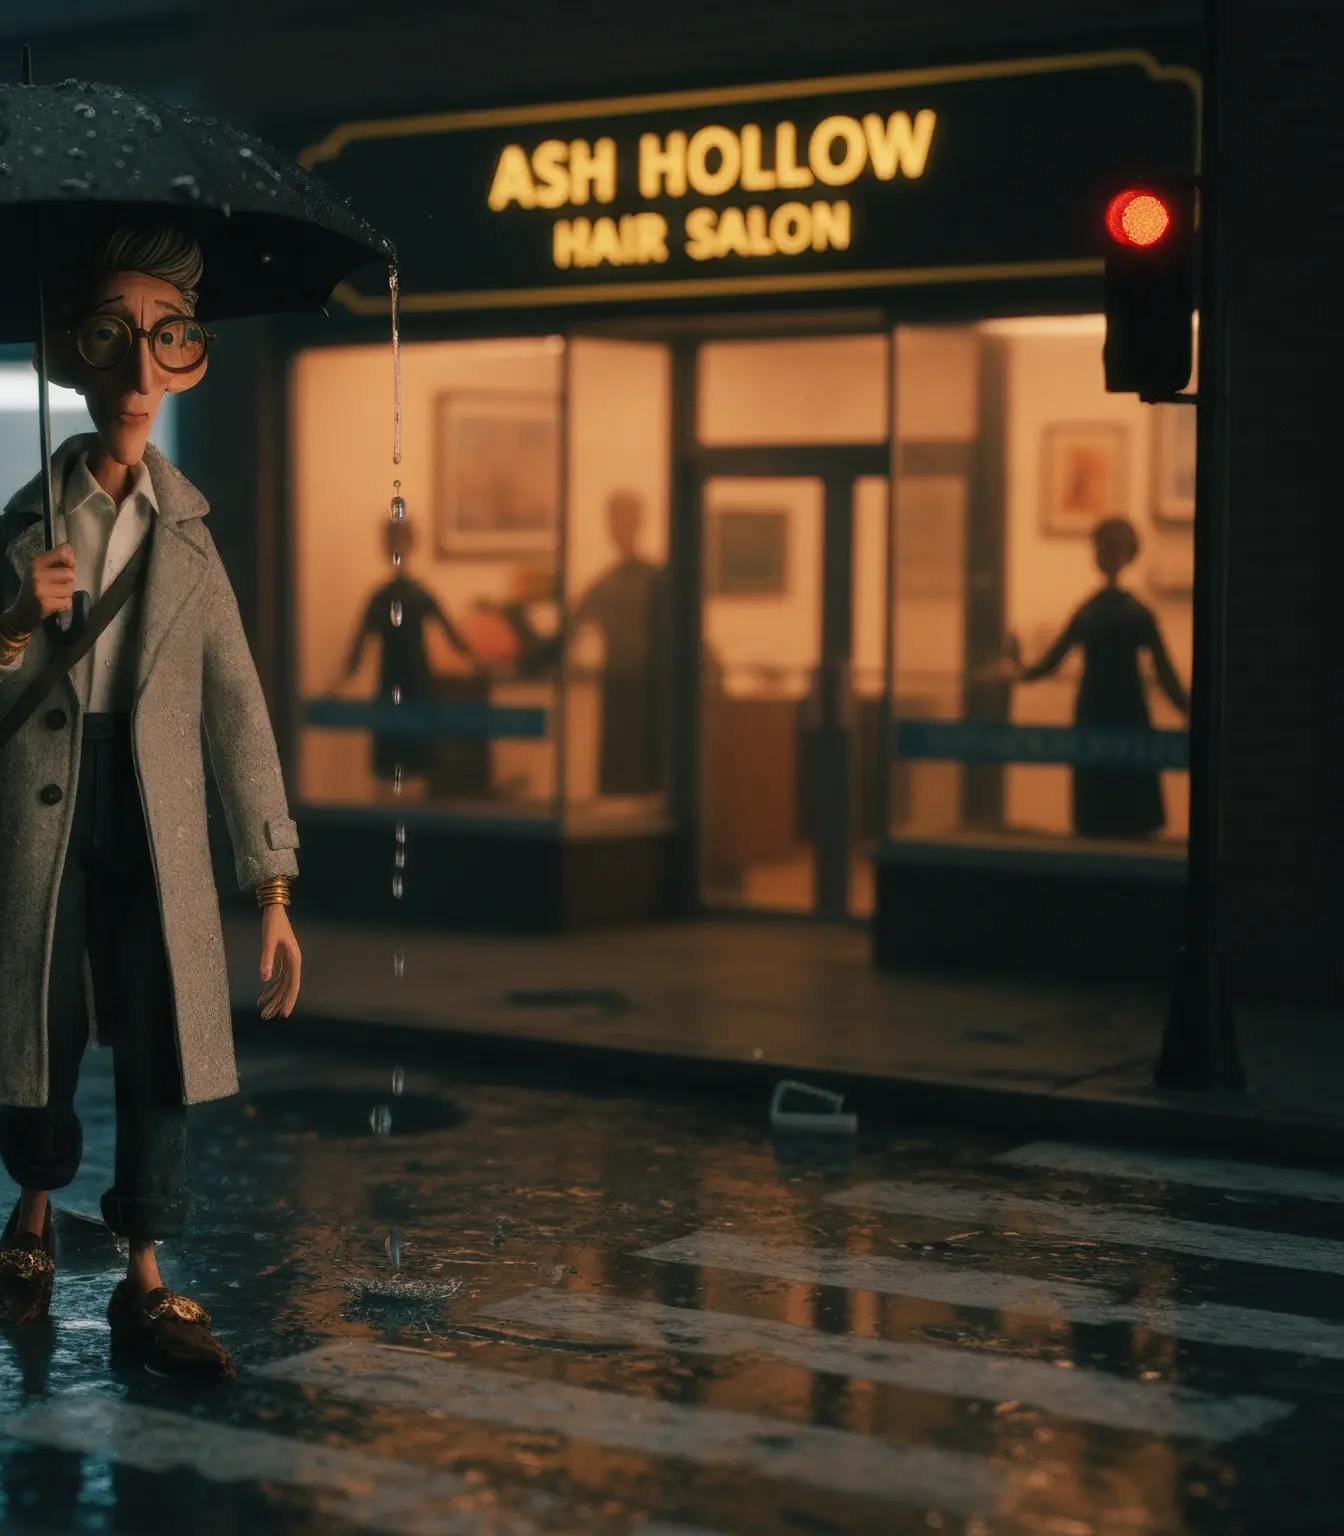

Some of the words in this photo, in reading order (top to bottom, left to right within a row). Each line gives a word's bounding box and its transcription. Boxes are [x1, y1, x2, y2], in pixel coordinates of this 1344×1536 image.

[488, 138, 616, 212] ASH
[639, 109, 936, 198] HOLLOW
[553, 212, 668, 268] HAIR
[685, 201, 851, 261] SALON
